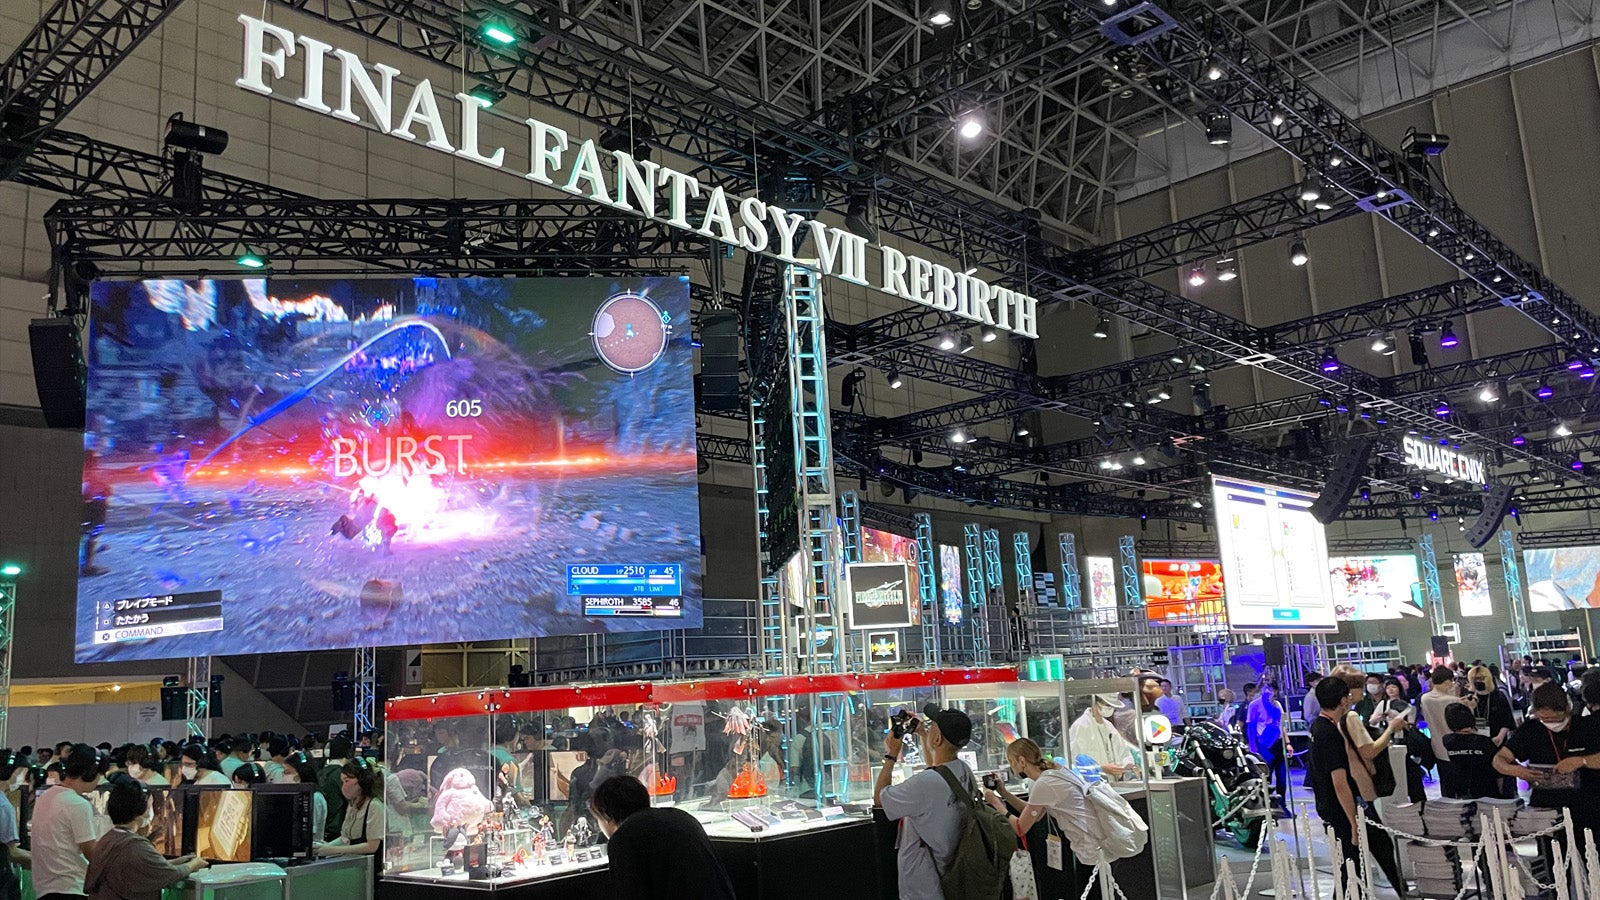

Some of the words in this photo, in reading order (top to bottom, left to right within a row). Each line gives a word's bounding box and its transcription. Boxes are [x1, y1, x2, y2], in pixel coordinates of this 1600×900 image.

[235, 14, 505, 169] FINAL
[525, 117, 806, 262] FANTASY
[809, 219, 870, 285] VII
[880, 245, 1040, 339] REBIRTH
[446, 399, 482, 418] 605
[334, 434, 473, 477] BURST
[1403, 436, 1458, 477] SQUARE
[1457, 453, 1486, 484] ENIX
[571, 566, 599, 575] CLOUD
[623, 566, 646, 575] 2510
[663, 566, 675, 575] 45
[585, 598, 624, 606] SEPHIROTH
[632, 597, 653, 606] 3585
[669, 598, 680, 607] 46
[116, 613, 150, 626] たたかう
[114, 626, 164, 639] COMMAND
